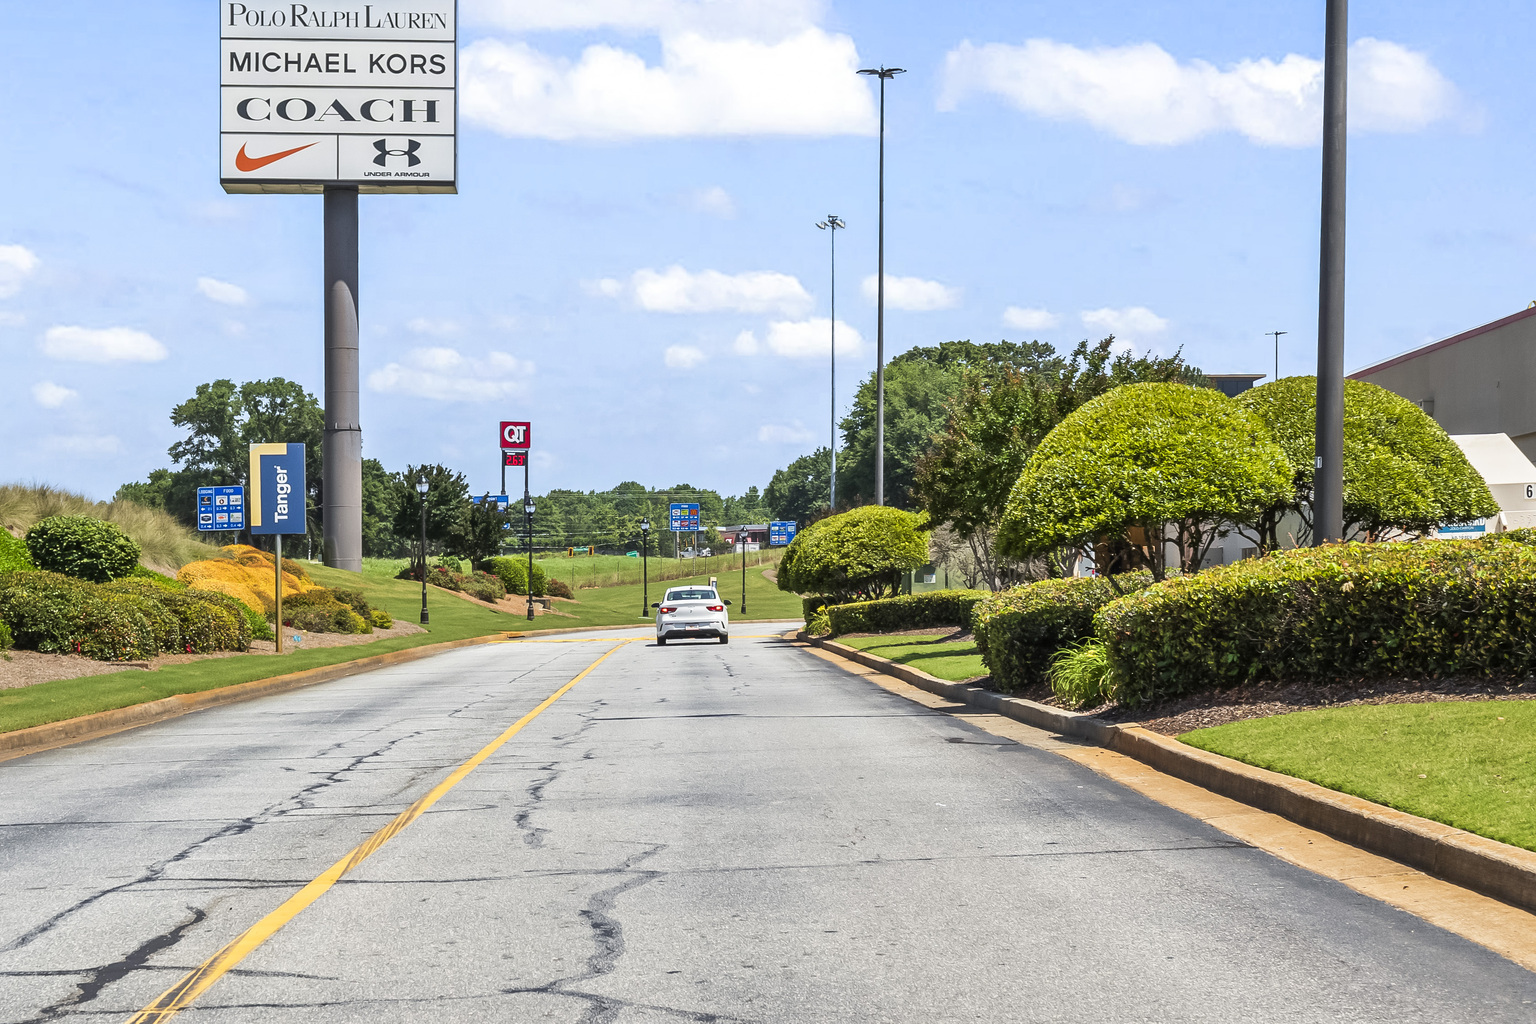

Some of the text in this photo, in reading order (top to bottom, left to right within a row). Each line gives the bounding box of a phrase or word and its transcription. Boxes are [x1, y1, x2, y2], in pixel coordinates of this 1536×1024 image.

[228, 3, 447, 30] POLO RALPH LAUREN
[229, 51, 446, 74] MICHAEL KORS
[236, 97, 440, 123] COACH
[504, 425, 526, 443] QT
[274, 466, 291, 523] Tanger
[1526, 484, 1533, 498] 6
